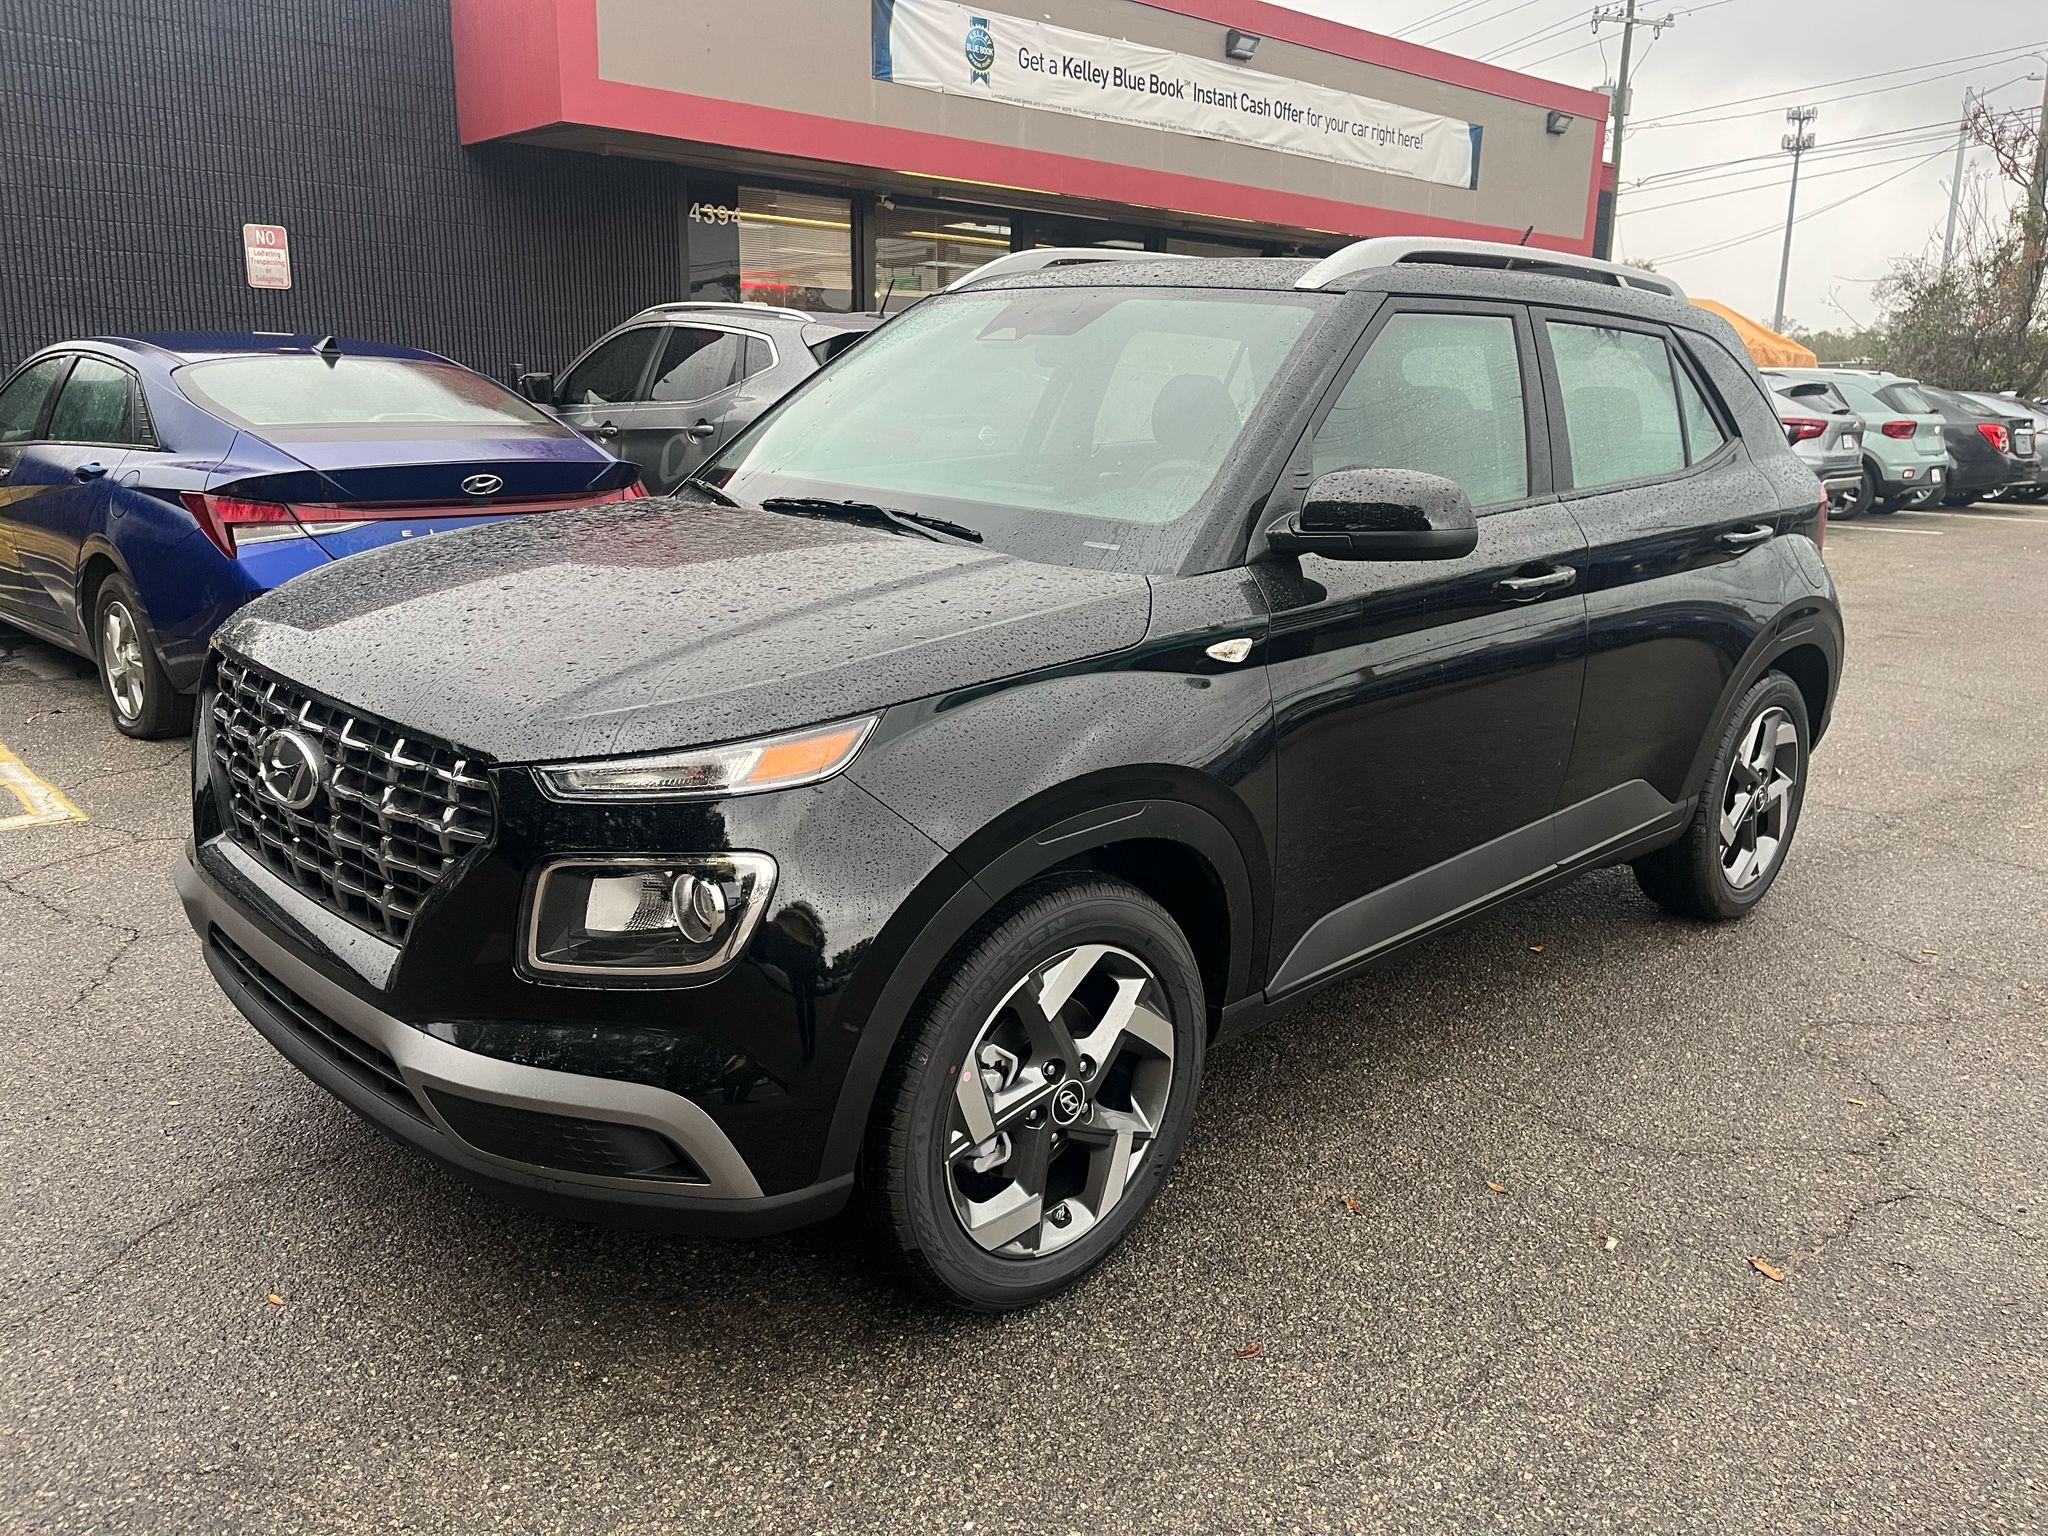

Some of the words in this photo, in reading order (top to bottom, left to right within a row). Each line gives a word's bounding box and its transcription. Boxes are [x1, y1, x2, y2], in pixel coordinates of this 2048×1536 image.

[969, 30, 992, 45] KELLEY
[966, 42, 980, 54] BLUE
[980, 45, 994, 56] BOOK
[1018, 47, 1045, 73] Get
[1048, 59, 1058, 75] a
[1062, 56, 1109, 90] Kelley
[1113, 66, 1146, 92] Blue
[1149, 73, 1184, 100] Book
[1193, 82, 1238, 110] Instant
[1240, 93, 1271, 117] Cash
[1274, 100, 1305, 124] Offer
[1307, 107, 1323, 127] for
[1324, 115, 1350, 134] your
[1351, 122, 1370, 138] car
[1371, 123, 1396, 146] right
[1397, 128, 1424, 150] here!
[689, 202, 741, 226] 4394
[255, 229, 276, 246] NO
